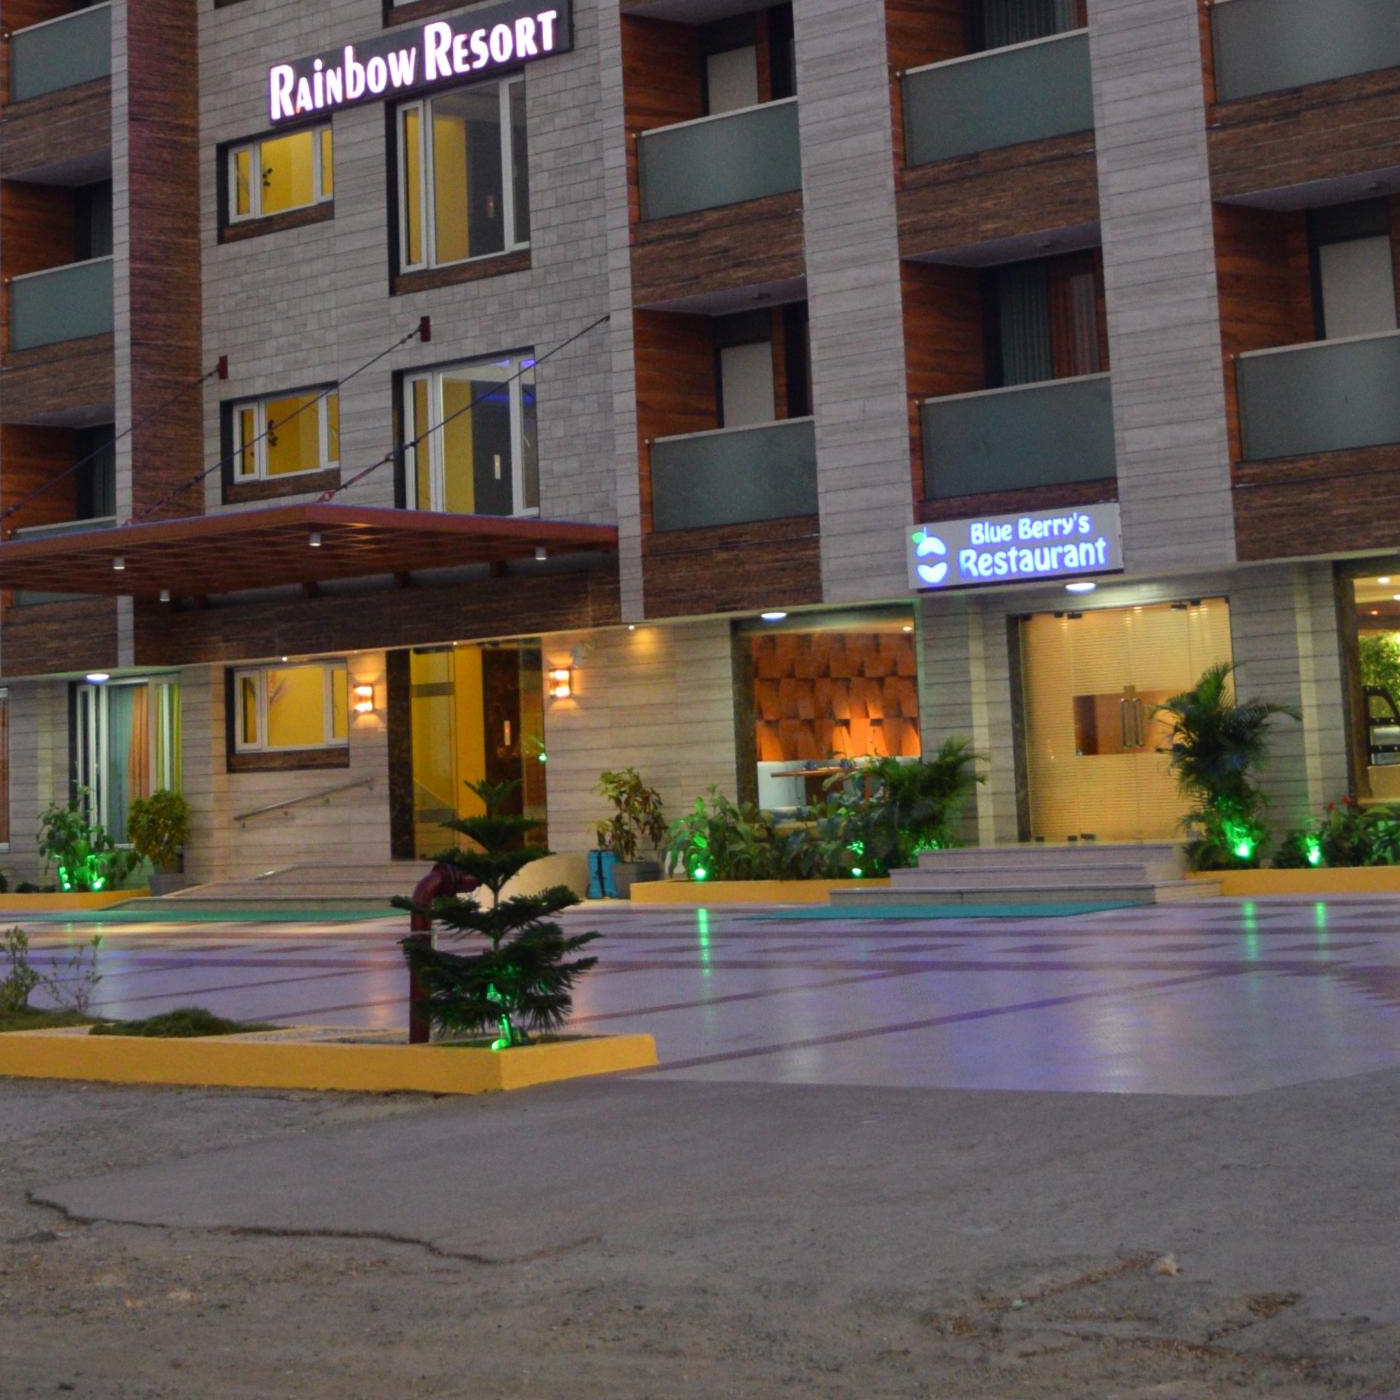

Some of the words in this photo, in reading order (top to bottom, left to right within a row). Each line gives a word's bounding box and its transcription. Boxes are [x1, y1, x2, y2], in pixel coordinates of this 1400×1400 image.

[423, 9, 558, 81] RESORT
[970, 522, 1013, 545] Blue
[1018, 512, 1090, 540] Berry's
[959, 536, 1107, 577] Restaurant
